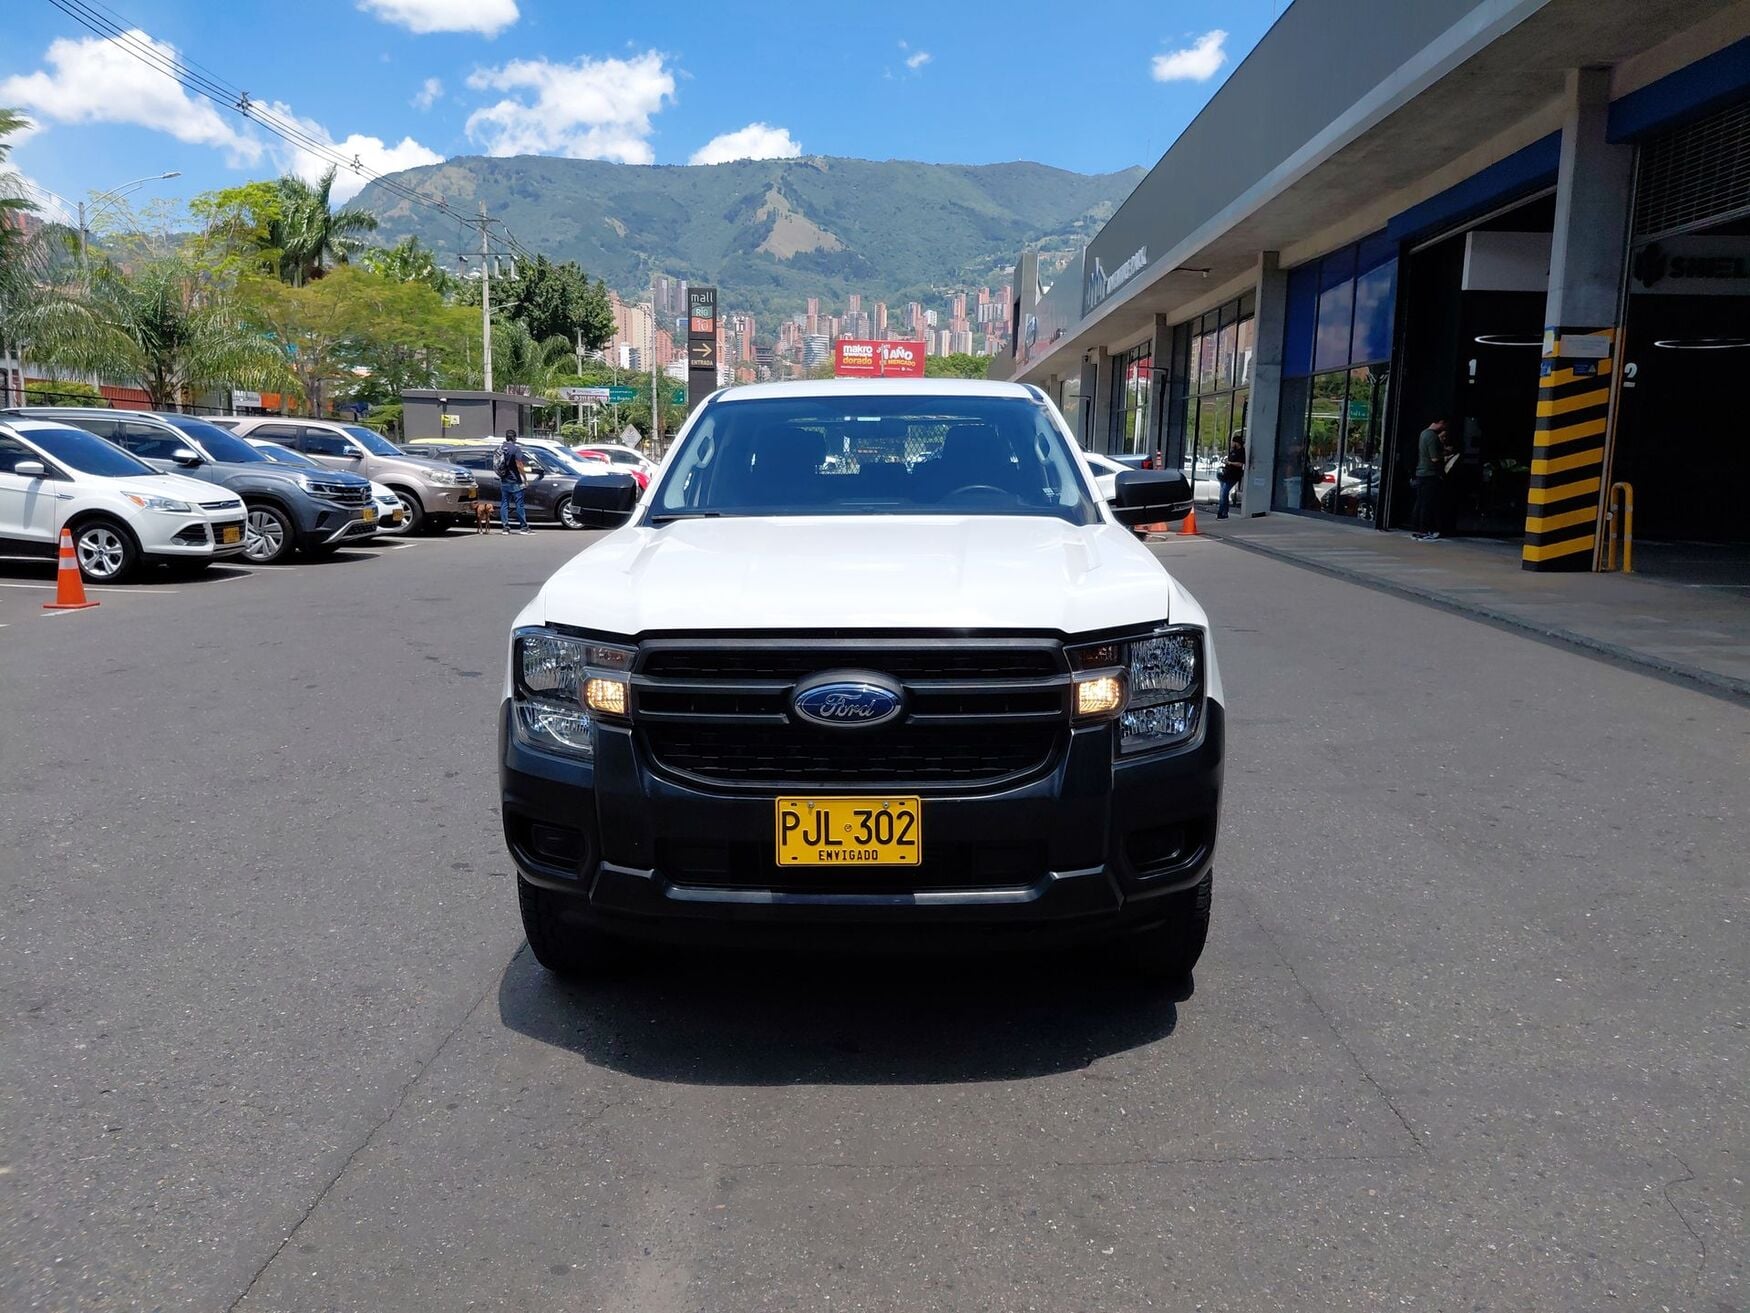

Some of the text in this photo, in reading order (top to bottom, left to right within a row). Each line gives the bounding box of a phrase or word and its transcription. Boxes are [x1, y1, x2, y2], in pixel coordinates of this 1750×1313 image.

[691, 291, 713, 302] mall
[843, 345, 873, 353] makro
[890, 346, 913, 360] AÑO
[842, 357, 873, 365] dorado
[1468, 359, 1477, 377] 1
[1624, 362, 1638, 378] 2
[820, 693, 877, 717] Ford
[781, 810, 915, 846] PJL 302
[818, 849, 878, 861] ENVIGADO
